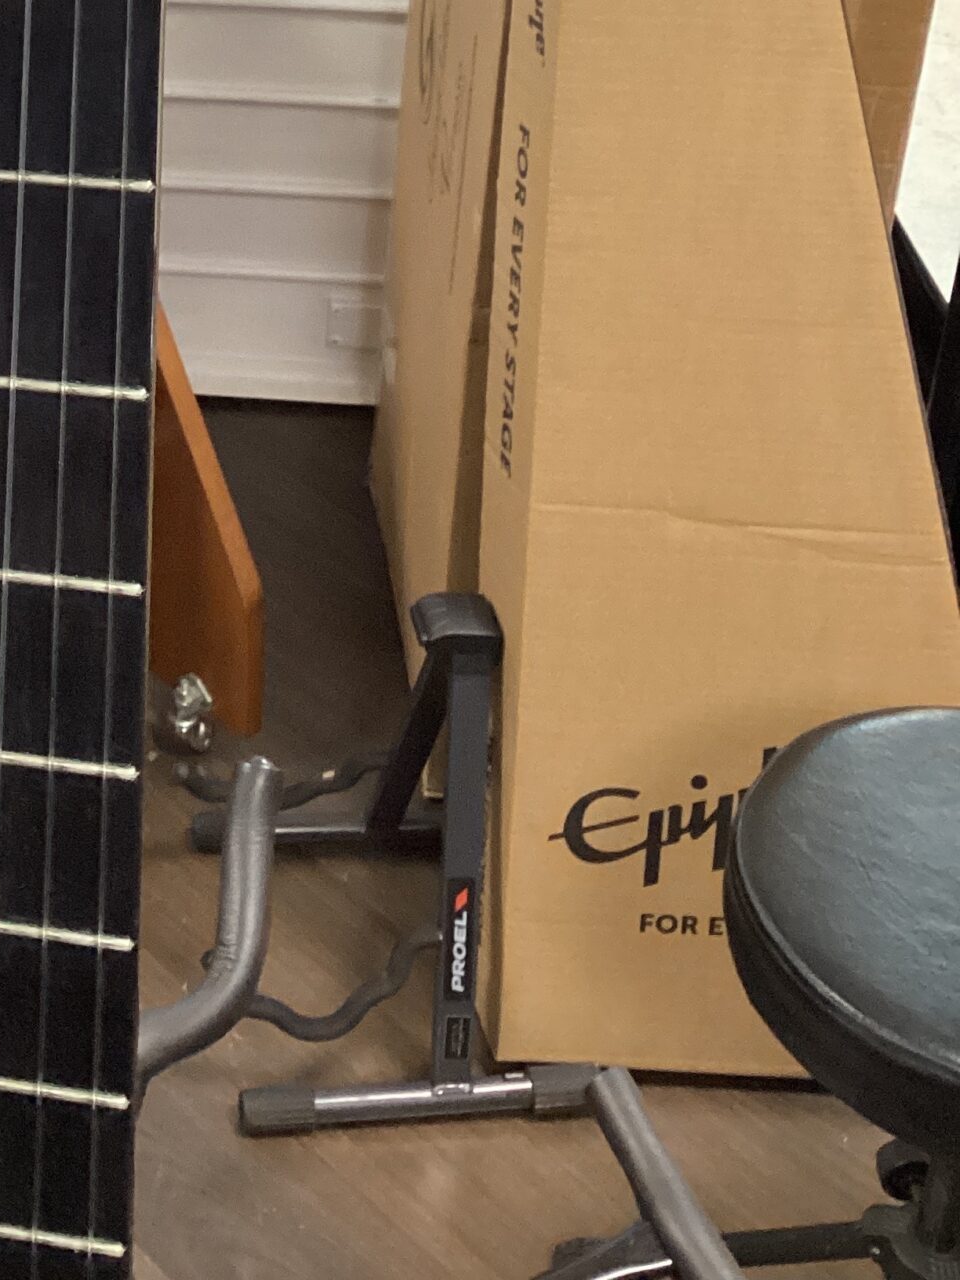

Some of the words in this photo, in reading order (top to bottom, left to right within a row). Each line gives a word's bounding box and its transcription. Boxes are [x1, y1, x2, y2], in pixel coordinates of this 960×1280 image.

[515, 124, 531, 207] FOR
[507, 216, 524, 347] EVERY
[500, 348, 517, 479] STAGE
[451, 910, 468, 993] PROEL
[639, 913, 698, 934] FOR
